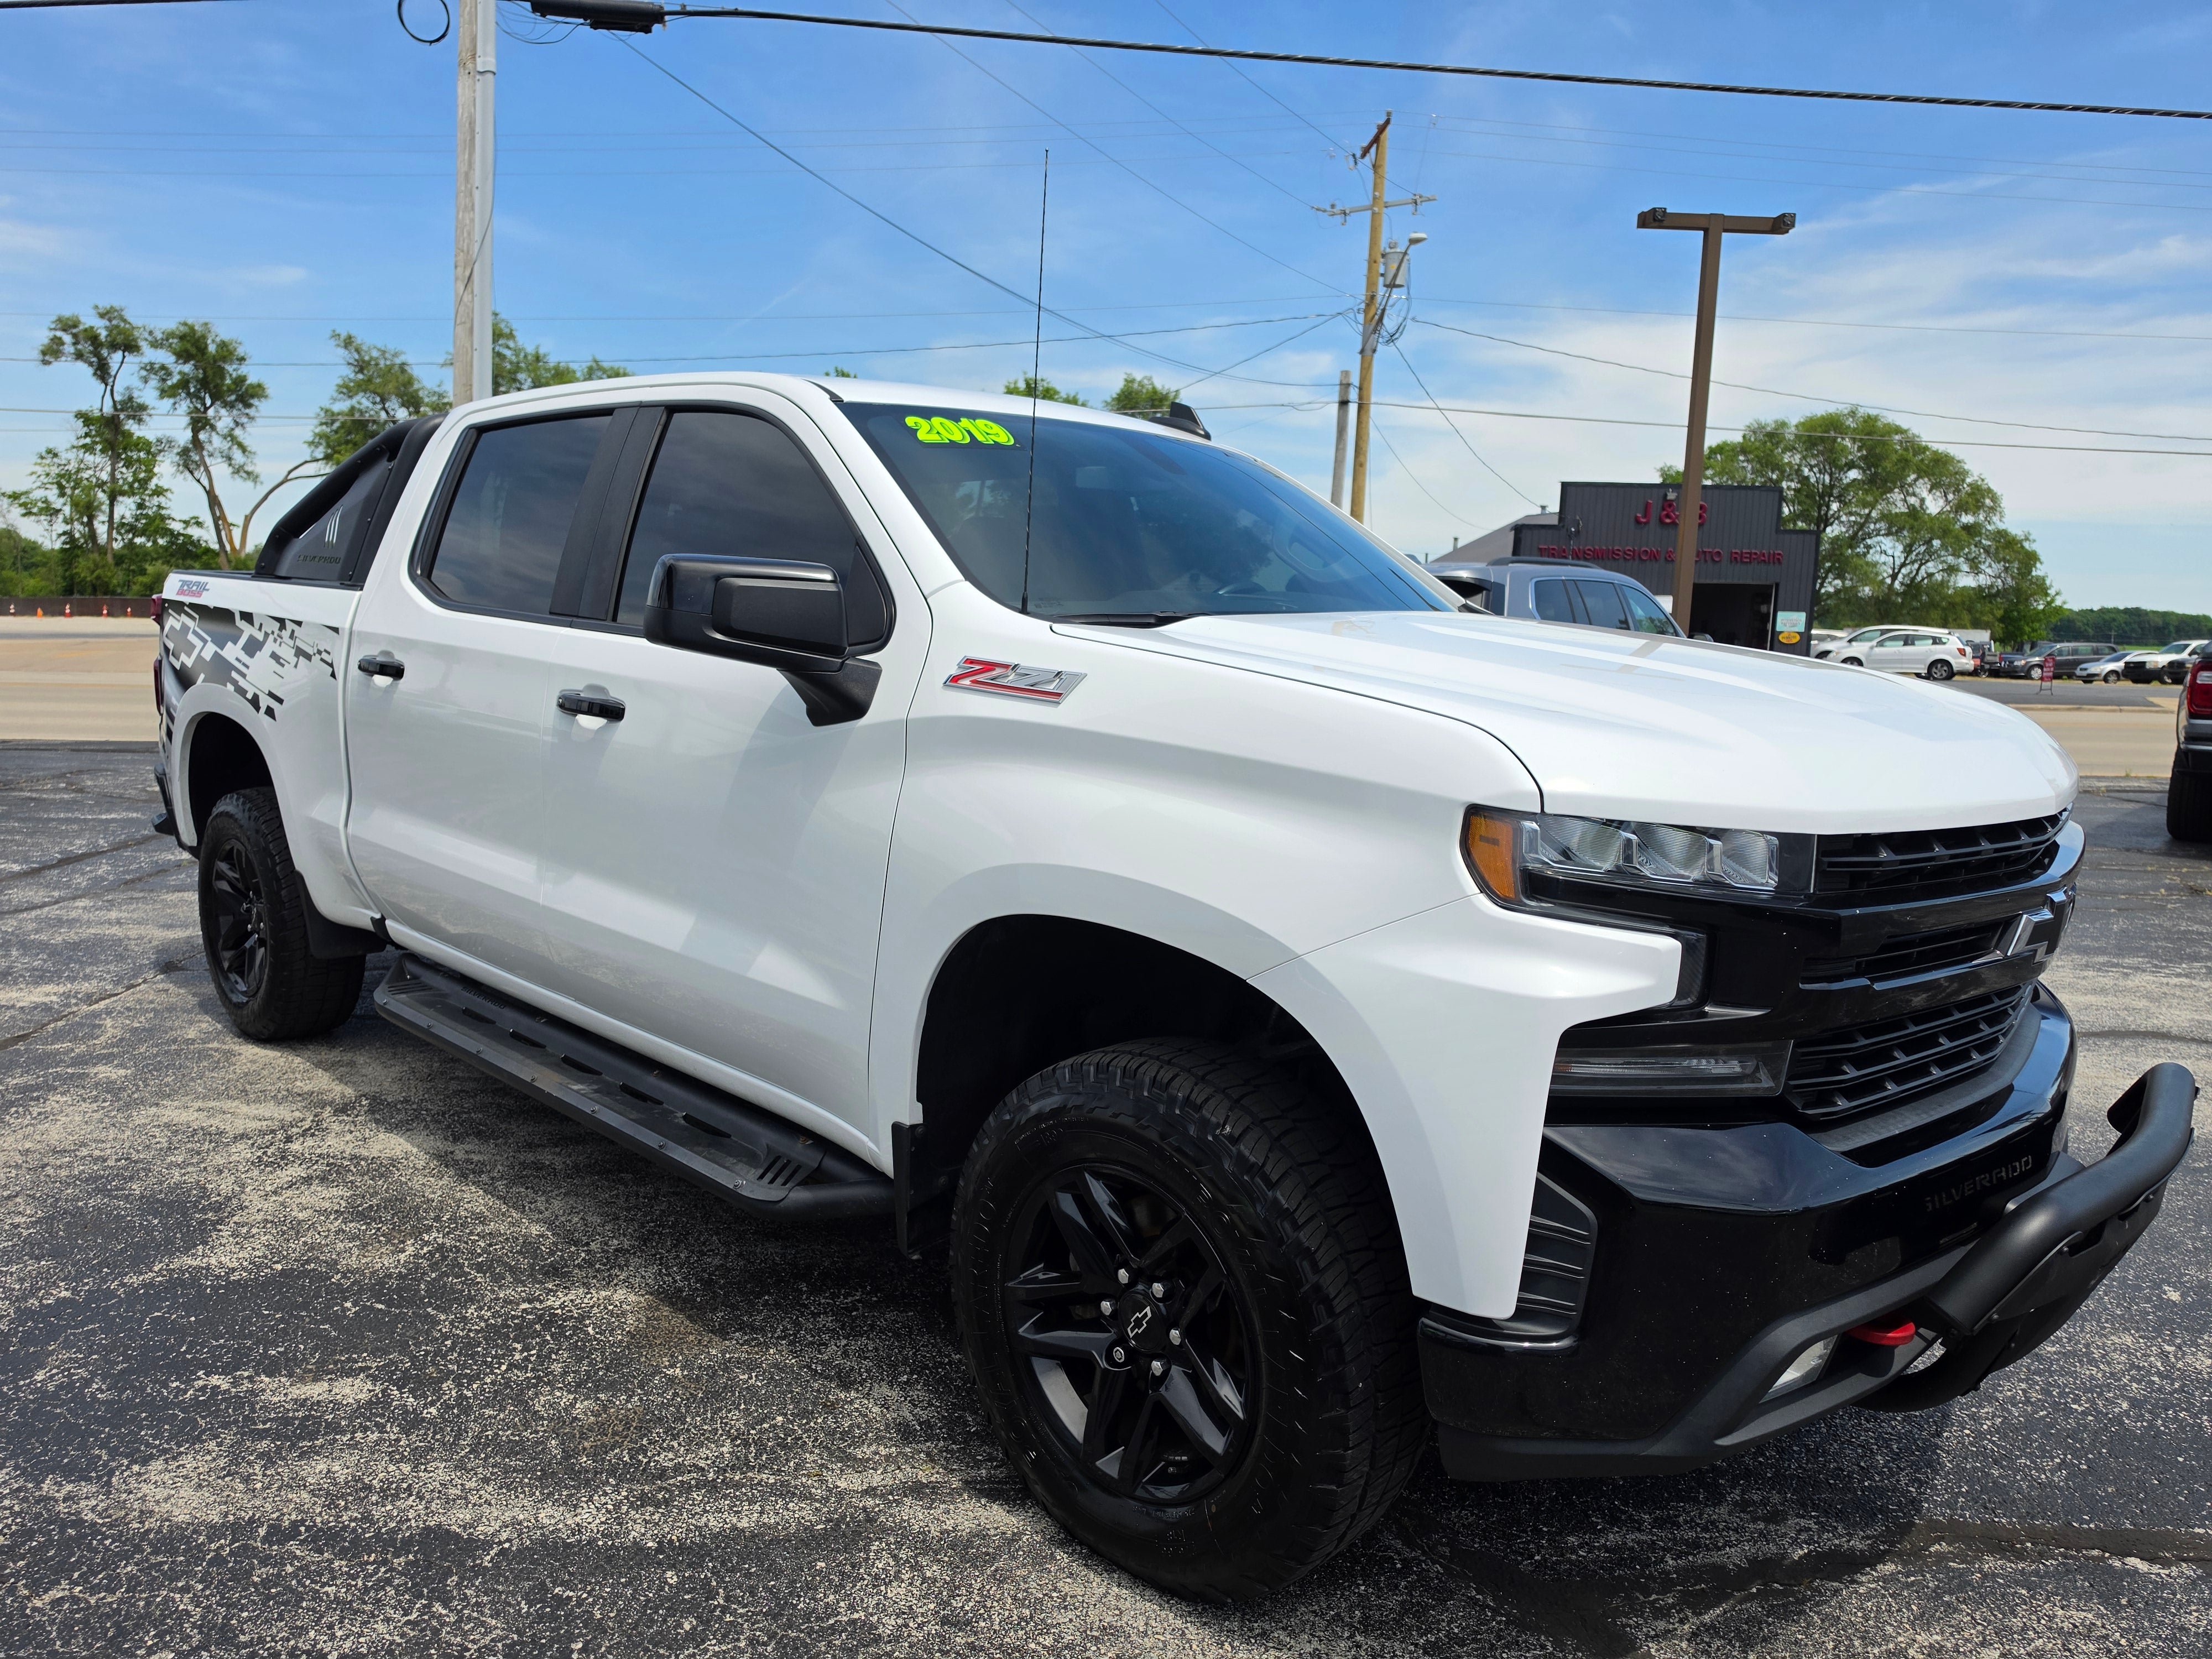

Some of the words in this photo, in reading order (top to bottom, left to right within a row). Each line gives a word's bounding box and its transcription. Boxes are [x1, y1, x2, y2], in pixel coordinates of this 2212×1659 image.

[905, 416, 1015, 446] 2019
[1635, 499, 1653, 524] J
[1660, 500, 1680, 524] &
[1538, 545, 1661, 561] TRANSMISSION
[1665, 547, 1676, 561] &
[1694, 547, 1724, 562] UTO
[1730, 549, 1783, 563] REPAIR
[175, 589, 204, 598] BOSS
[178, 579, 210, 592] TRAIL
[942, 655, 1087, 704] Z71
[1924, 1155, 2032, 1212] SILVERADO
